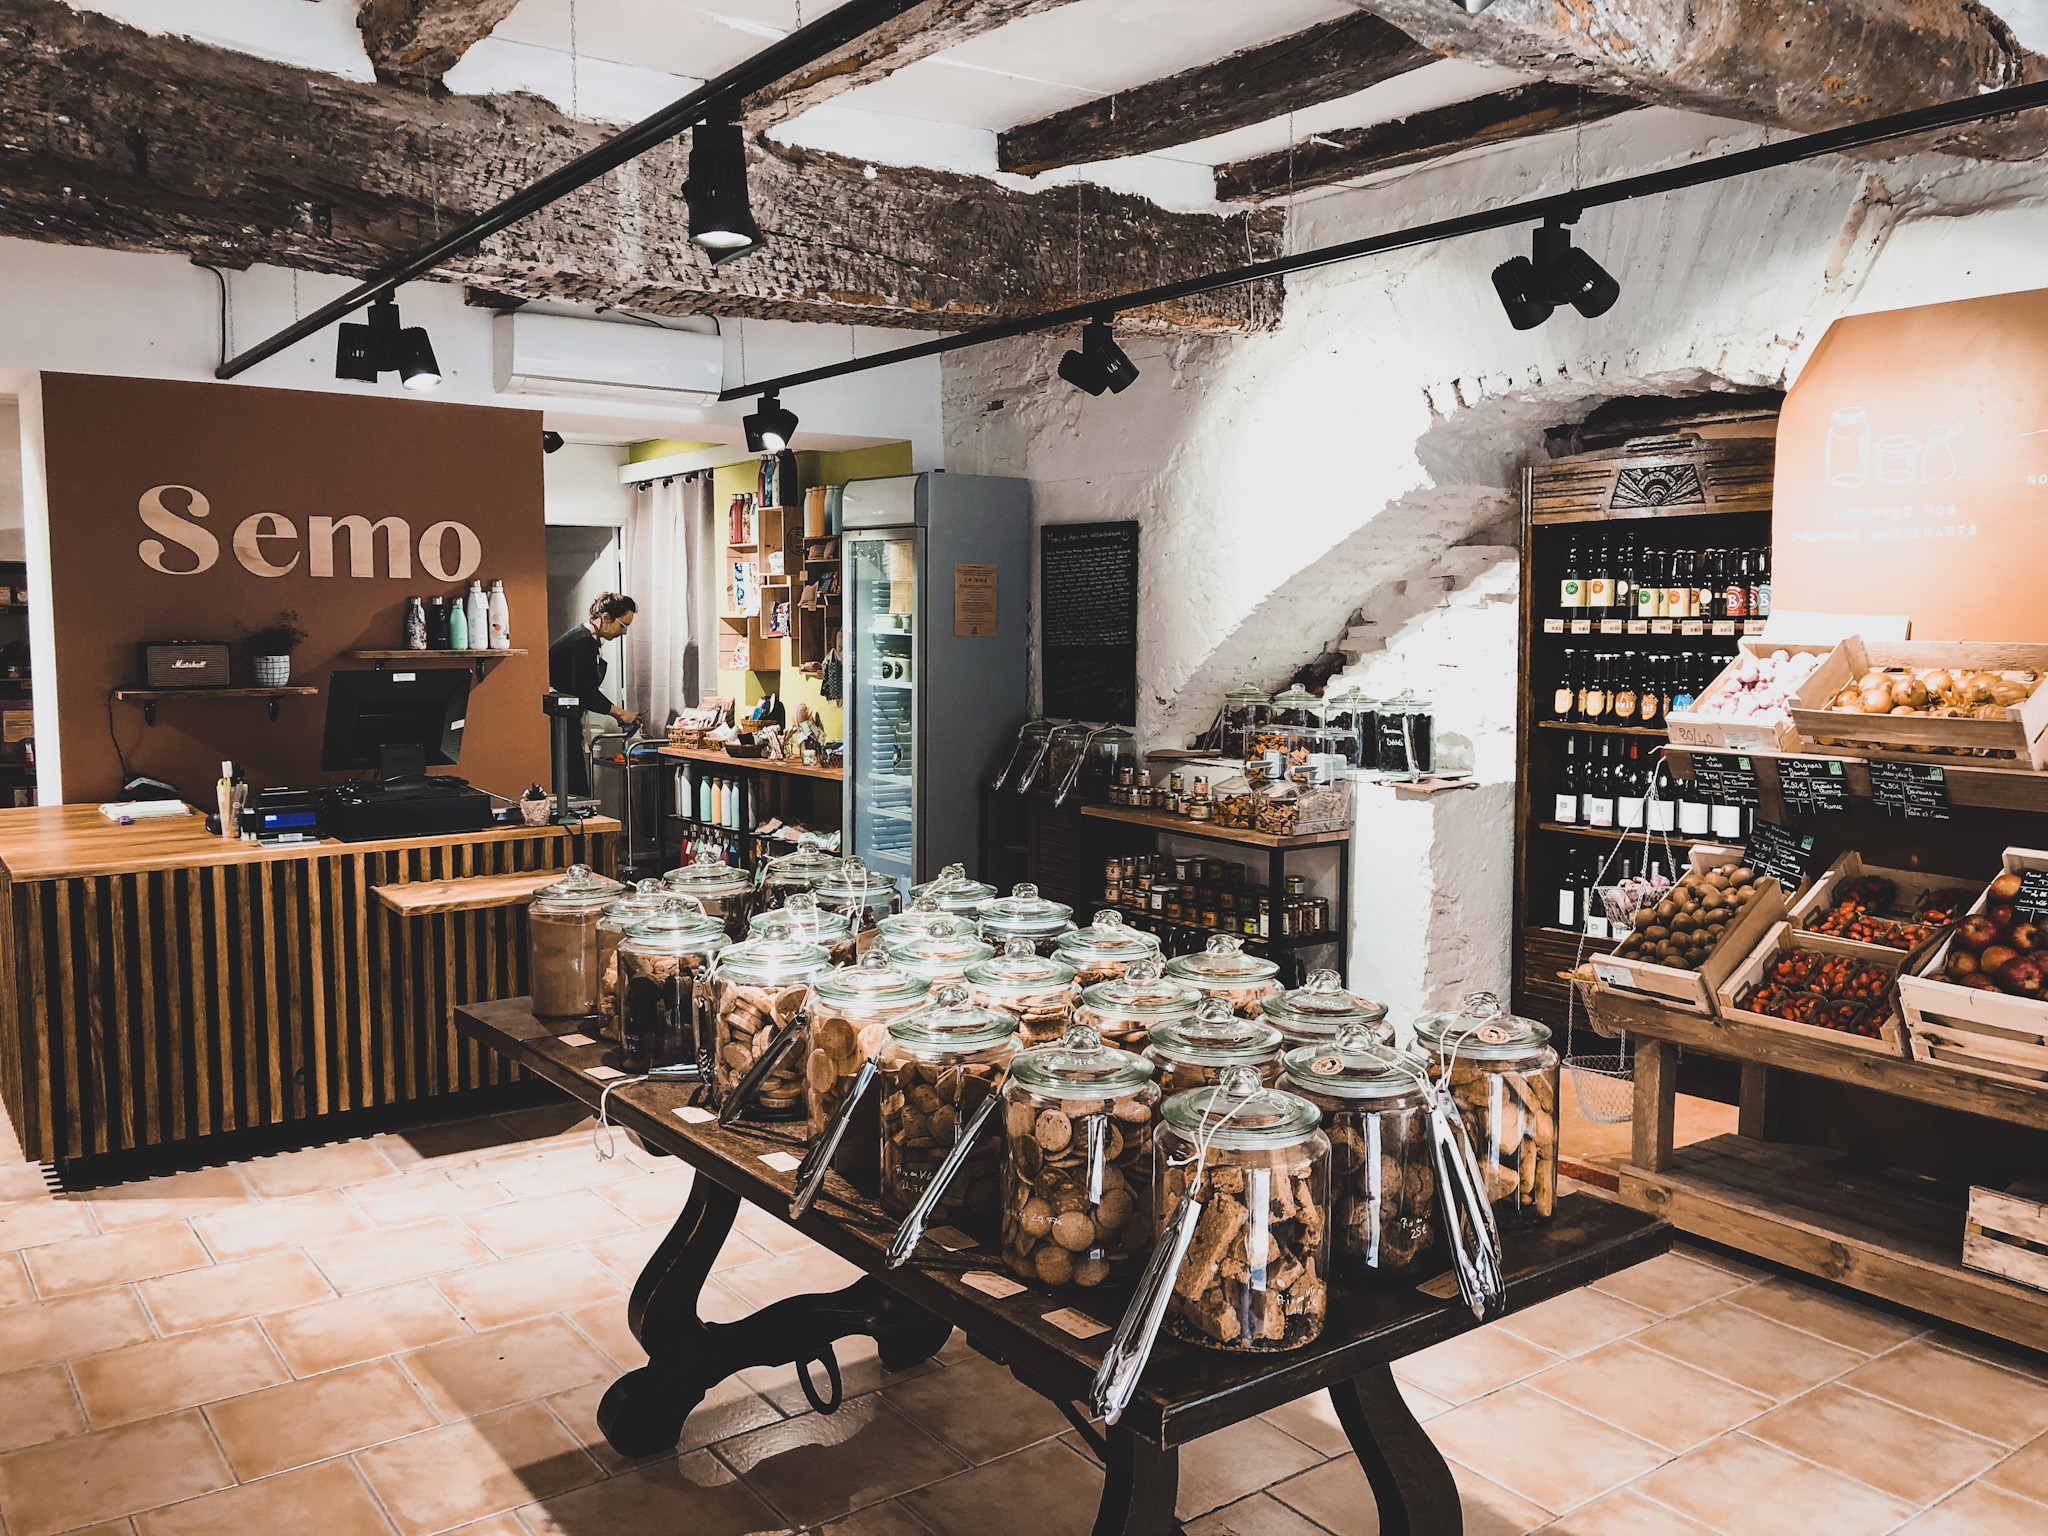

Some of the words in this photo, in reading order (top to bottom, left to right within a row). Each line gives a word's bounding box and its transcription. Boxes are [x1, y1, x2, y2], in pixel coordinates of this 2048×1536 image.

[1924, 504, 1957, 518] VOS
[138, 483, 482, 582] Semo
[1678, 727, 1713, 746] 20/40
[1276, 1293, 1295, 1306] Prix
